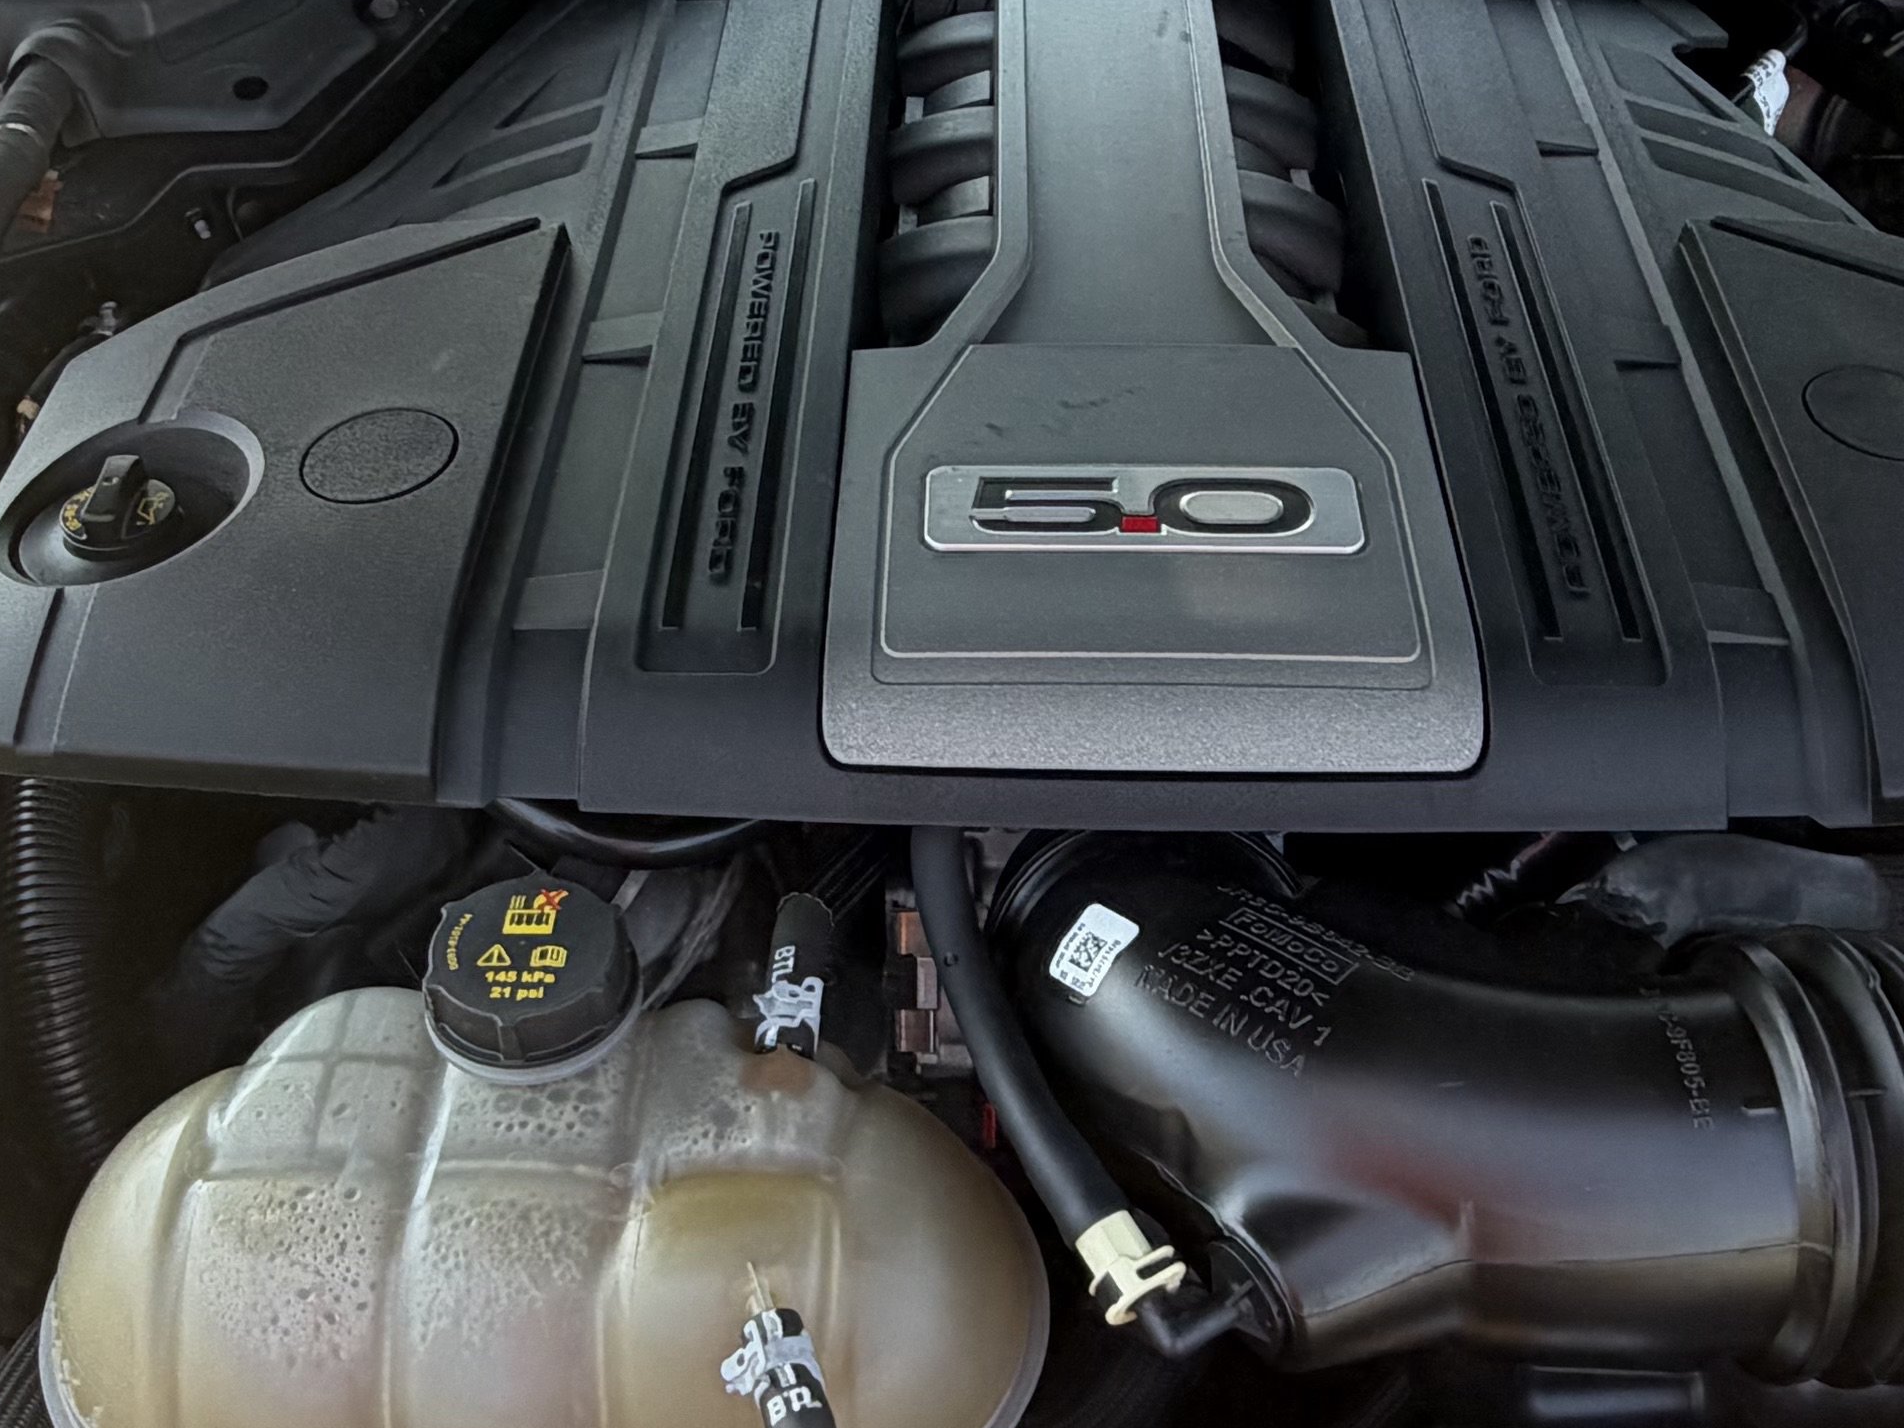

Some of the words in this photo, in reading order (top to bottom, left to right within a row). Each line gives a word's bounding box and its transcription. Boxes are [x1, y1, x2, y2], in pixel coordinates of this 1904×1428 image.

[1467, 234, 1510, 326] FORD
[737, 231, 781, 394] POWERED
[1495, 337, 1526, 386] BY
[727, 402, 756, 454] BY
[707, 465, 745, 579] FORD
[969, 474, 1316, 537] 5.0
[1514, 394, 1590, 597] POWERED
[771, 945, 796, 983] BTL
[1232, 912, 1340, 974] FoMoCo
[484, 970, 518, 984] 145
[521, 970, 557, 984] kPa
[488, 985, 512, 1000] 21
[515, 985, 545, 1002] psi
[1133, 963, 1211, 1020] MADE
[1211, 1002, 1249, 1037] IN
[1246, 1024, 1306, 1077] USA
[1313, 1026, 1332, 1047] 1
